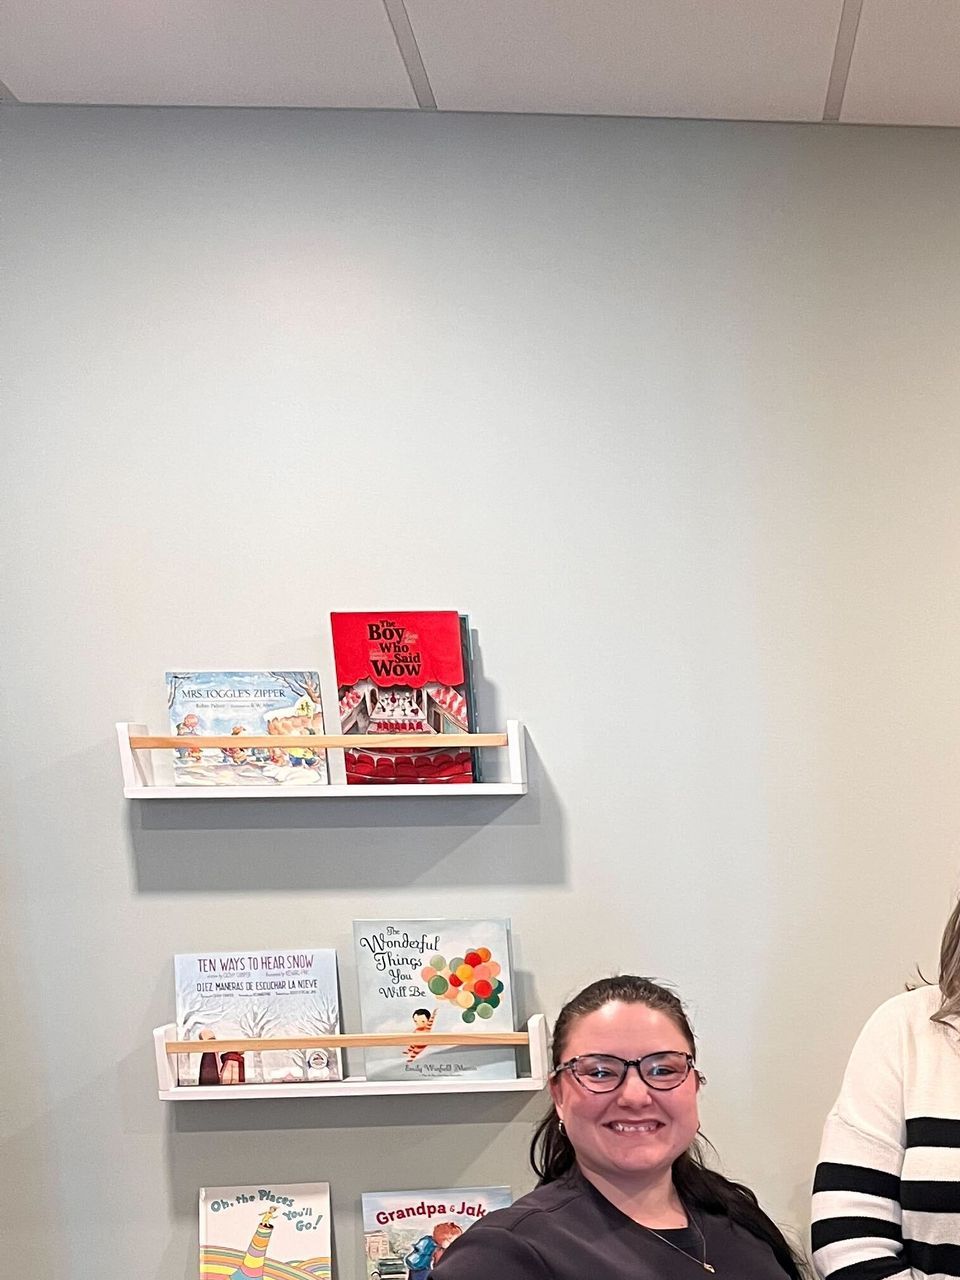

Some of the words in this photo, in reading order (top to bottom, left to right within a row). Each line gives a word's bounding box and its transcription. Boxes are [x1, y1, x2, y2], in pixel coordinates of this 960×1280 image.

[379, 620, 396, 628] The
[367, 623, 406, 644] Boy
[379, 641, 410, 653] Who
[394, 652, 421, 664] Said
[370, 659, 422, 676] Wow
[253, 688, 287, 698] ZIPPER
[386, 926, 400, 936] The
[359, 932, 440, 953] Wonderful
[197, 958, 216, 972] TEN
[219, 957, 246, 971] WAYS
[248, 956, 259, 970] TO
[260, 955, 285, 970] HEAR
[286, 954, 314, 969] SNOW
[373, 951, 422, 971] Things
[388, 968, 413, 984] You
[196, 982, 214, 992] DIEZ
[215, 981, 244, 991] MANERAS
[246, 982, 254, 991] DE
[255, 980, 287, 990] ESCUCHAR
[287, 980, 297, 990] LA
[297, 979, 318, 989] NIEVE
[378, 986, 407, 998] Will
[408, 985, 427, 997] Be
[235, 1193, 256, 1204] the
[257, 1189, 295, 1207] Places
[282, 1207, 313, 1221] You'll
[375, 1201, 447, 1225] Grandpa
[456, 1201, 486, 1218] Jak
[295, 1214, 324, 1232] Go!
